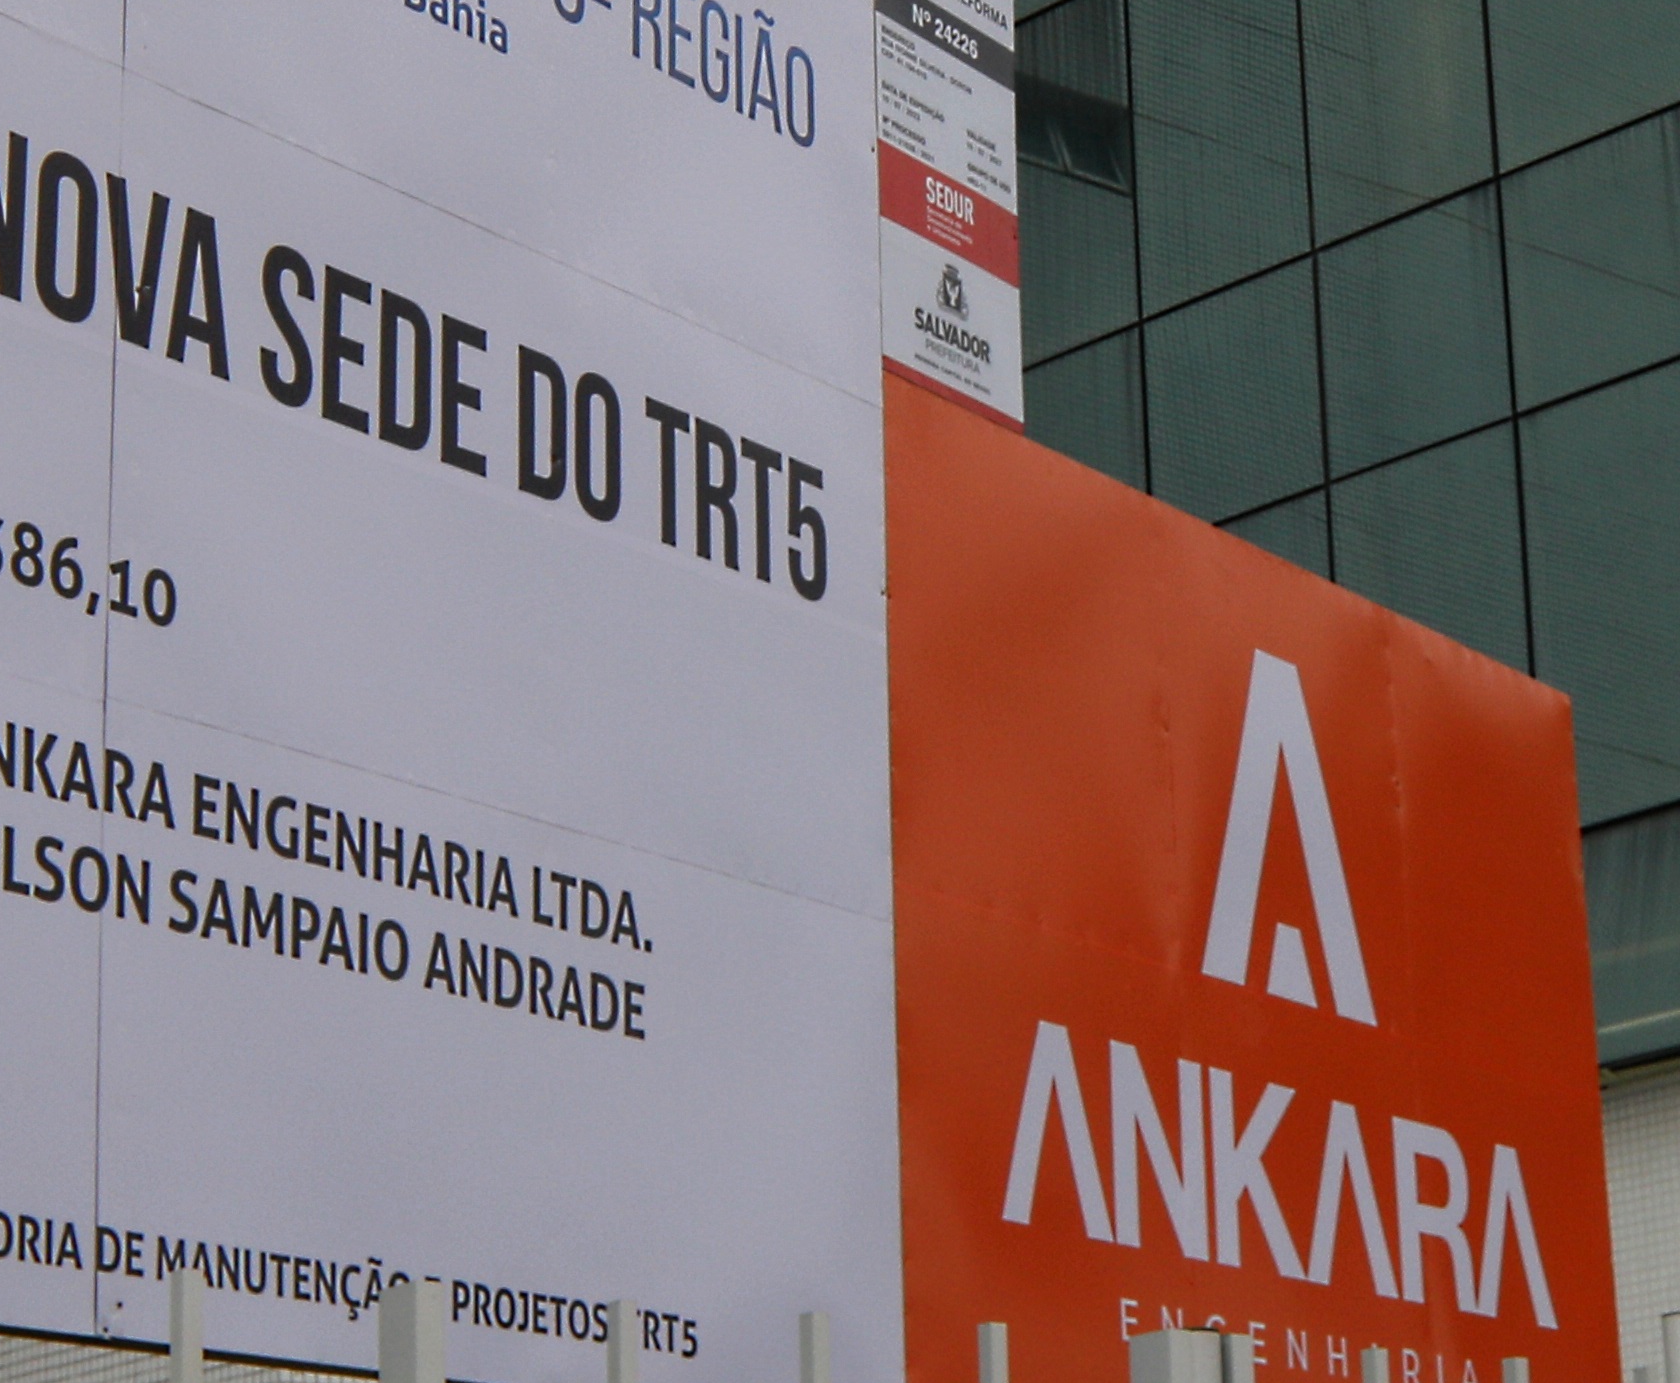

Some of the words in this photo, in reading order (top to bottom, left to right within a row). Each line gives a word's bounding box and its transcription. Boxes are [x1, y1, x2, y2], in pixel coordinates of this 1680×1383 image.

[935, 18, 979, 59] 24226
[925, 176, 975, 226] SEDUR
[914, 307, 991, 363] SALVADOR
[925, 338, 981, 374] PREFEITURA
[259, 245, 487, 478] SEDE
[519, 343, 621, 523] DO
[645, 396, 828, 601] TRT5
[193, 772, 519, 918] ENGENHARIA
[531, 866, 654, 954] LTDA.
[168, 869, 408, 982] SAMPAIO
[424, 932, 647, 1041] ANDRADE
[1001, 1019, 1559, 1330] ANKARA
[97, 1224, 144, 1279] DE
[452, 1279, 609, 1343] PROJETOS
[636, 1308, 698, 1359] RT5
